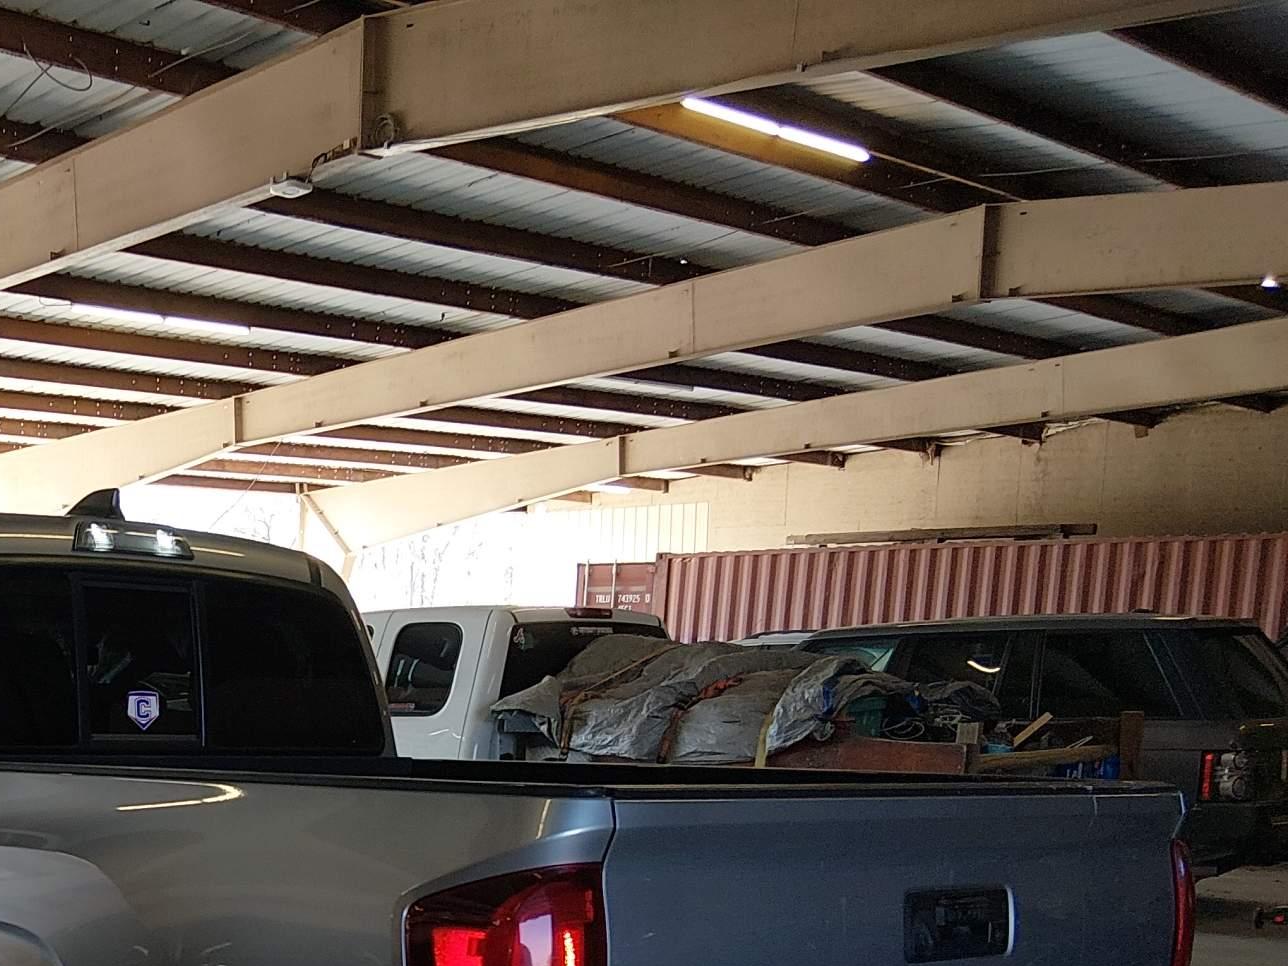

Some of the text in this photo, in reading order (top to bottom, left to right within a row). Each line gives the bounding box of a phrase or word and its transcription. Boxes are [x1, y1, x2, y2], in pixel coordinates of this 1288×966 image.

[595, 594, 610, 603] TRLU
[617, 594, 641, 603] 743925
[136, 698, 151, 720] C
